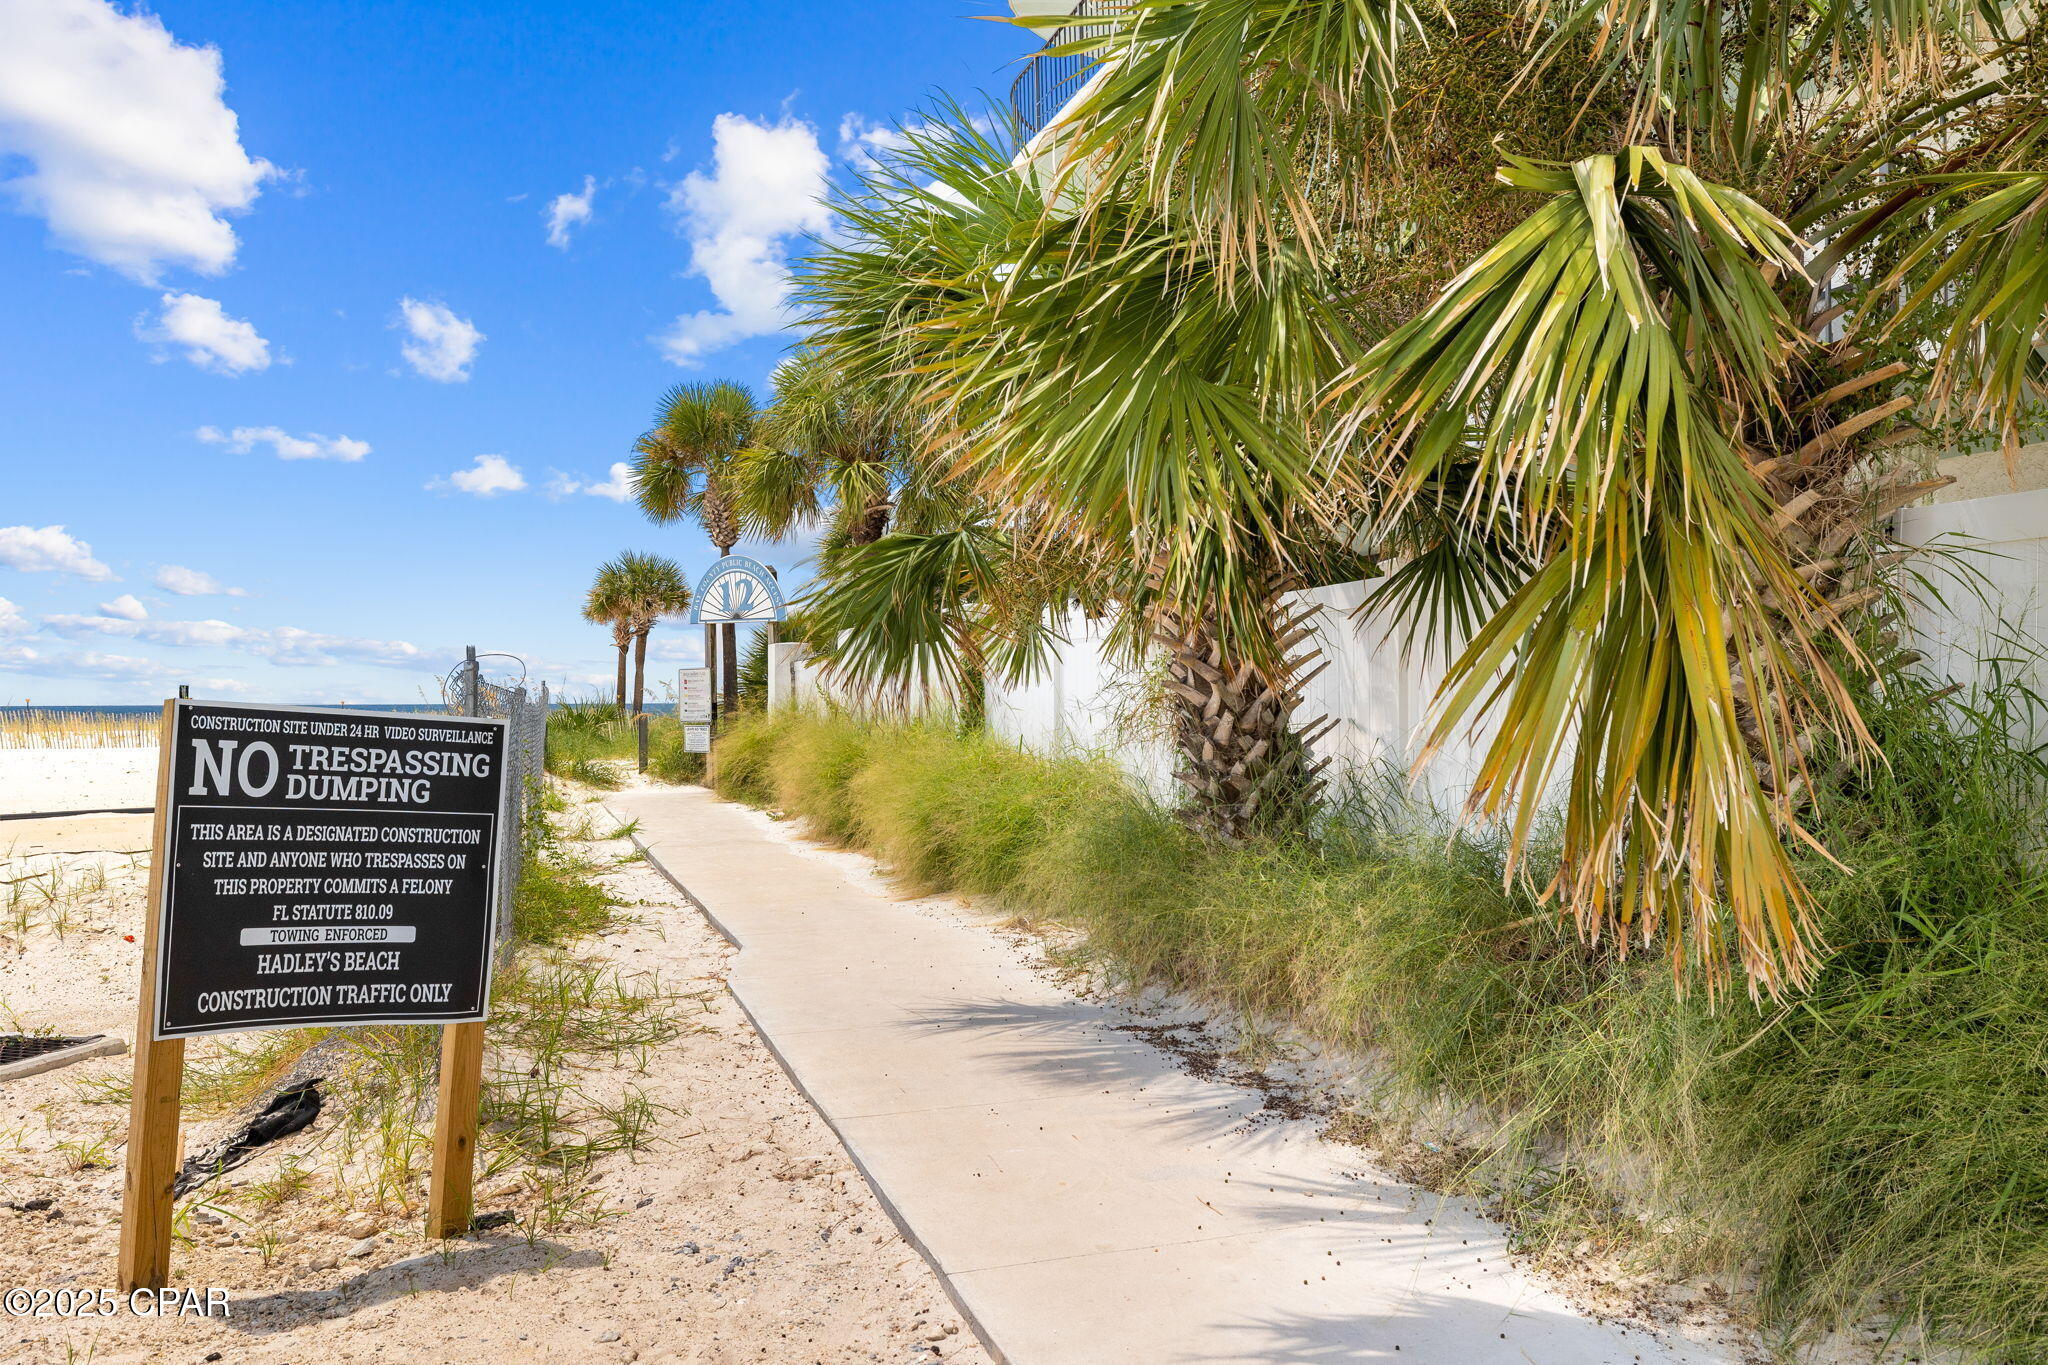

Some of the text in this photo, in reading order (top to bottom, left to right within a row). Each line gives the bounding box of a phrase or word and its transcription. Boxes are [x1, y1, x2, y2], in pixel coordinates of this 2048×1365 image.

[700, 565, 720, 592] COUNTY
[722, 559, 743, 569] PUBLIC
[744, 560, 765, 578] BEACH
[718, 579, 754, 612] 12
[191, 715, 493, 744] CONSTRUCTION SITE UNDER 24 HR VIDEO SURVEILLANCE
[189, 739, 278, 797] NO
[288, 744, 491, 778] TRESPASSING
[285, 773, 432, 804] DUMPING
[191, 824, 480, 844] THIS AREA IS A DESIGNATED CONSTRUCTION
[203, 852, 466, 869] SITE AND ANYONE WHO TRESPASSES ON
[214, 879, 453, 895] THIS PROPERTY COMMITS A FELONY
[273, 904, 393, 920] FL STATUTE 810.09
[271, 928, 388, 942] TOWING ENFORCED
[257, 952, 400, 974] HADLEY'S BEACH
[198, 984, 452, 1013] CONSTRUCTION TRAFFIC ONLY
